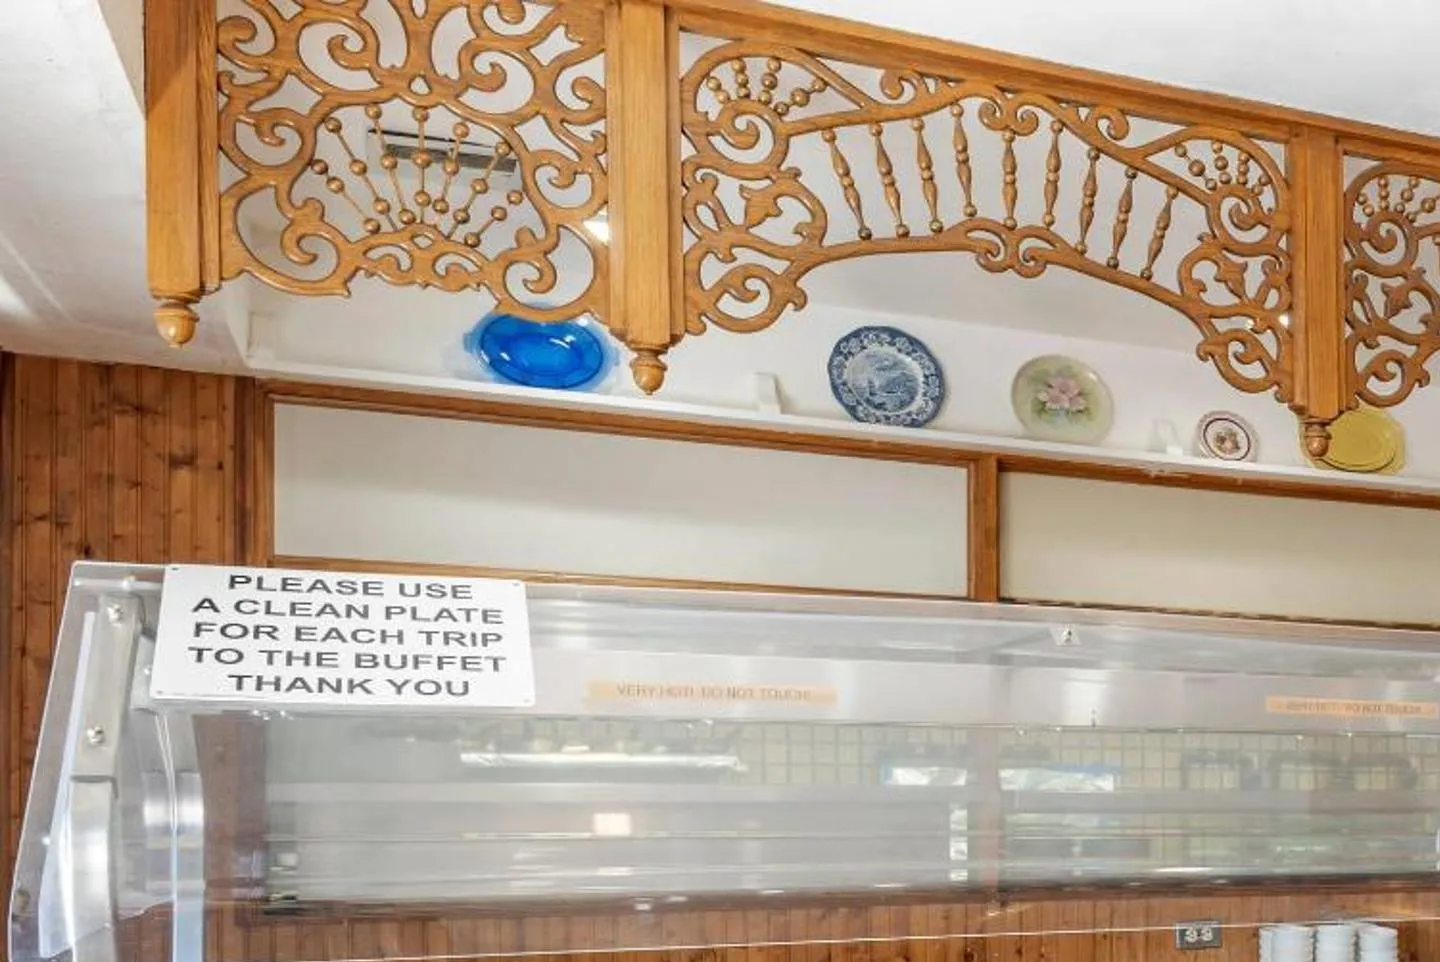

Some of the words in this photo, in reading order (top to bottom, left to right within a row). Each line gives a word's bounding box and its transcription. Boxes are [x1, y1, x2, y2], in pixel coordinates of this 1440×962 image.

[228, 574, 385, 596] PLEASE
[398, 583, 473, 600] USE
[192, 597, 221, 614] A
[234, 599, 370, 619] CLEAN
[384, 605, 504, 625] PLATE
[193, 622, 280, 642] FOR
[294, 626, 405, 646] EACH
[418, 630, 503, 649] TRIP
[188, 646, 245, 666] TO
[258, 649, 340, 669] THE
[354, 653, 507, 673] BUFFET
[228, 674, 375, 696] THANK
[385, 678, 470, 698] YOU
[616, 683, 657, 698] VERY
[726, 686, 753, 699] NOT
